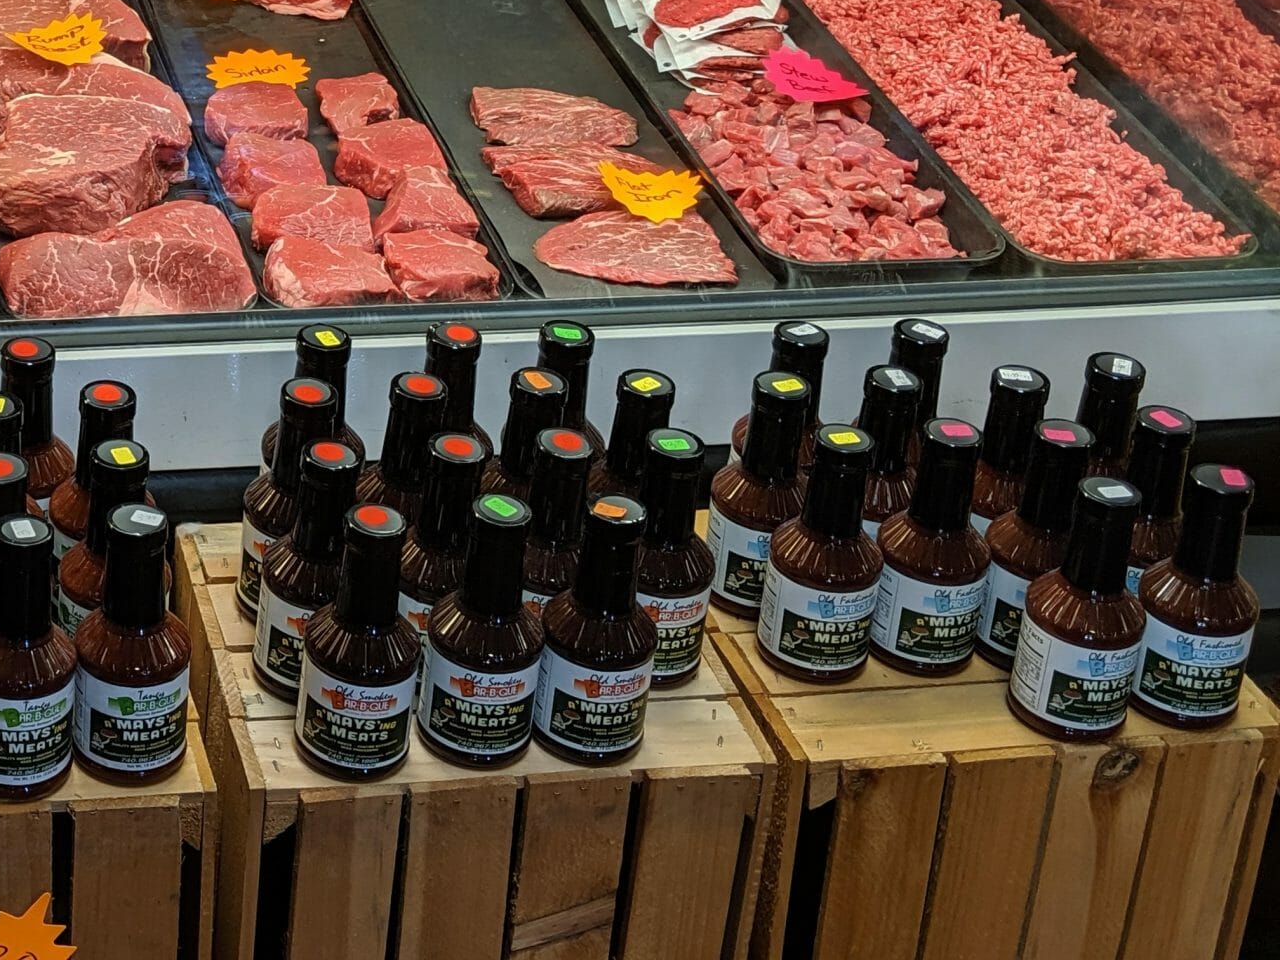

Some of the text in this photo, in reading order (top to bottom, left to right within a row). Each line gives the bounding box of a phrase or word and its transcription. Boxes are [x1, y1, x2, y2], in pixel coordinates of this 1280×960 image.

[225, 64, 287, 79] Sirloin
[779, 63, 829, 83] Stew
[650, 600, 670, 612] Old
[815, 630, 865, 644] MEATS
[1176, 634, 1243, 648] Old Fashioned
[464, 673, 485, 686] Old
[590, 673, 609, 685] Old
[1175, 674, 1233, 690] MEATS
[137, 689, 165, 701] Tangy
[334, 685, 355, 699] Old
[23, 699, 51, 712] Tangy
[460, 712, 518, 728] MEATS
[585, 710, 639, 727] MEATS
[122, 723, 177, 742] MEATS
[331, 725, 389, 742] MEATS
[8, 733, 63, 754] MEATS
